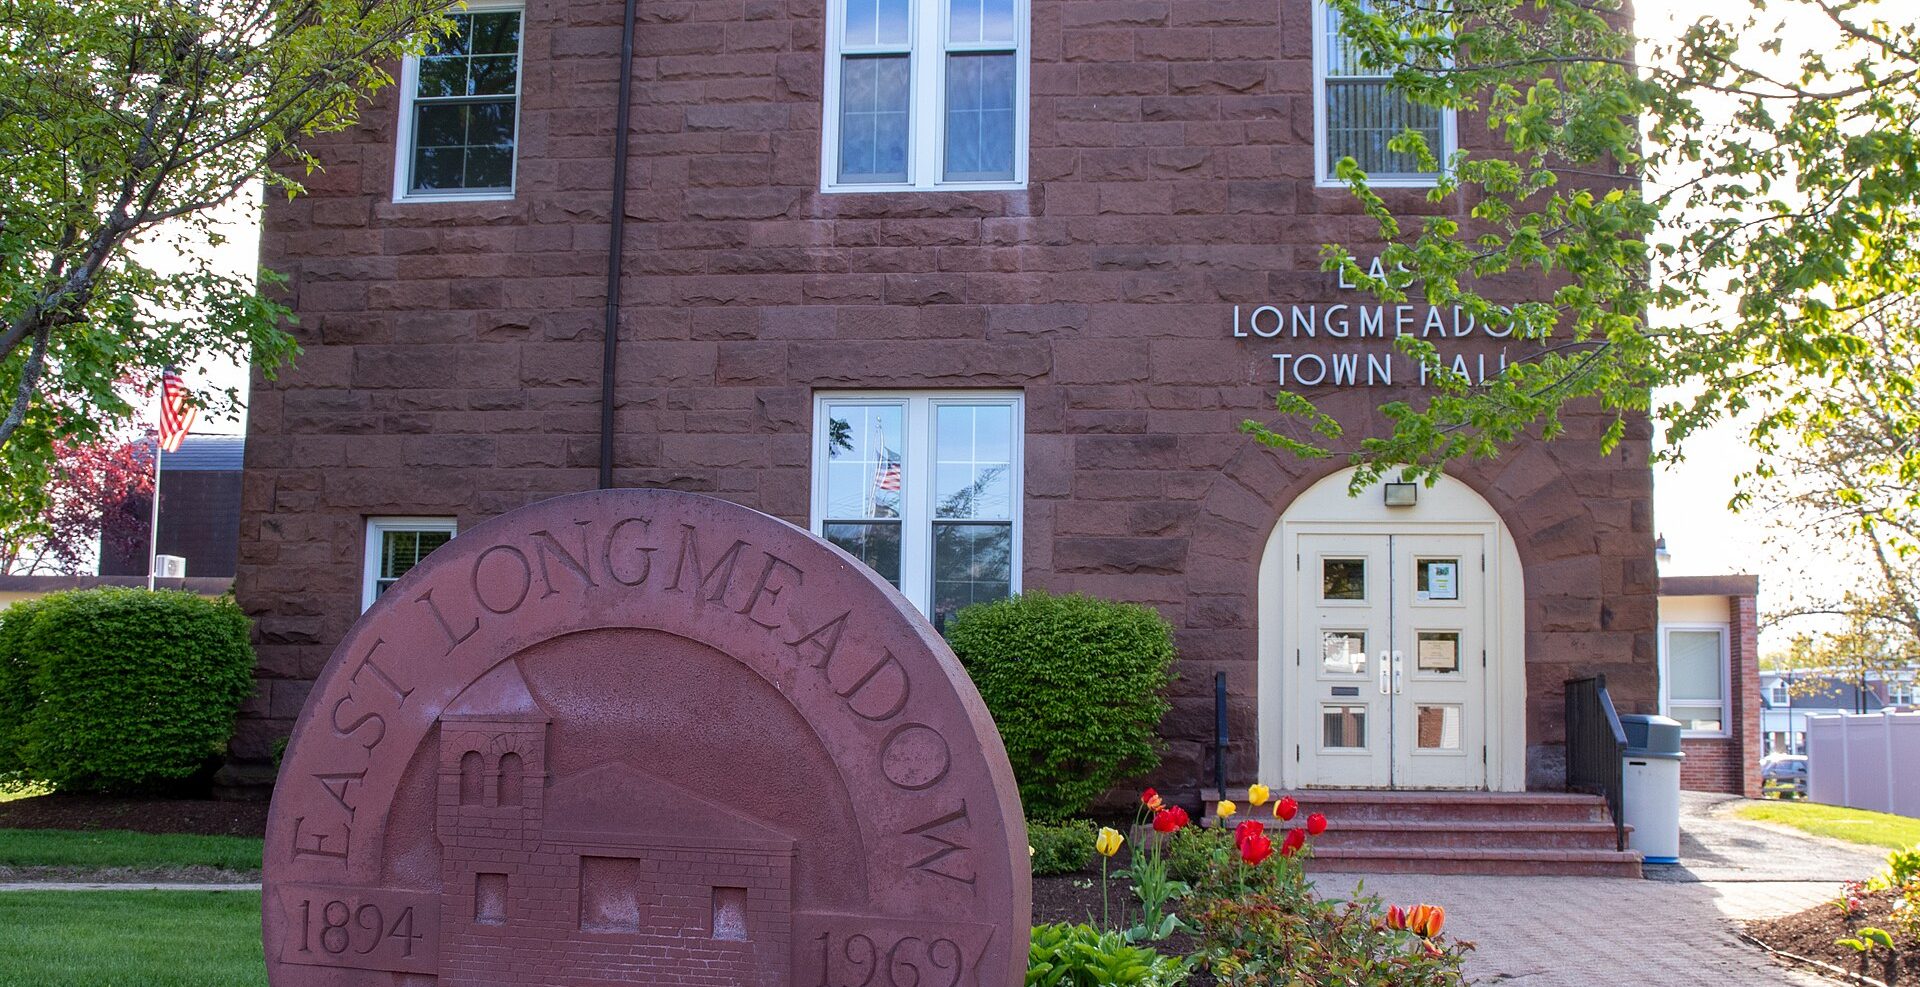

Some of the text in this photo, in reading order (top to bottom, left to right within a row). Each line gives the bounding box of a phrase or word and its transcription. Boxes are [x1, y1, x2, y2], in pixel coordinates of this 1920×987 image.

[1339, 256, 1418, 289] EAS
[1272, 353, 1391, 386] TOWN
[291, 517, 977, 888] EAST LONGMEADOW
[299, 900, 423, 957] 1894
[815, 932, 963, 987] 1969
